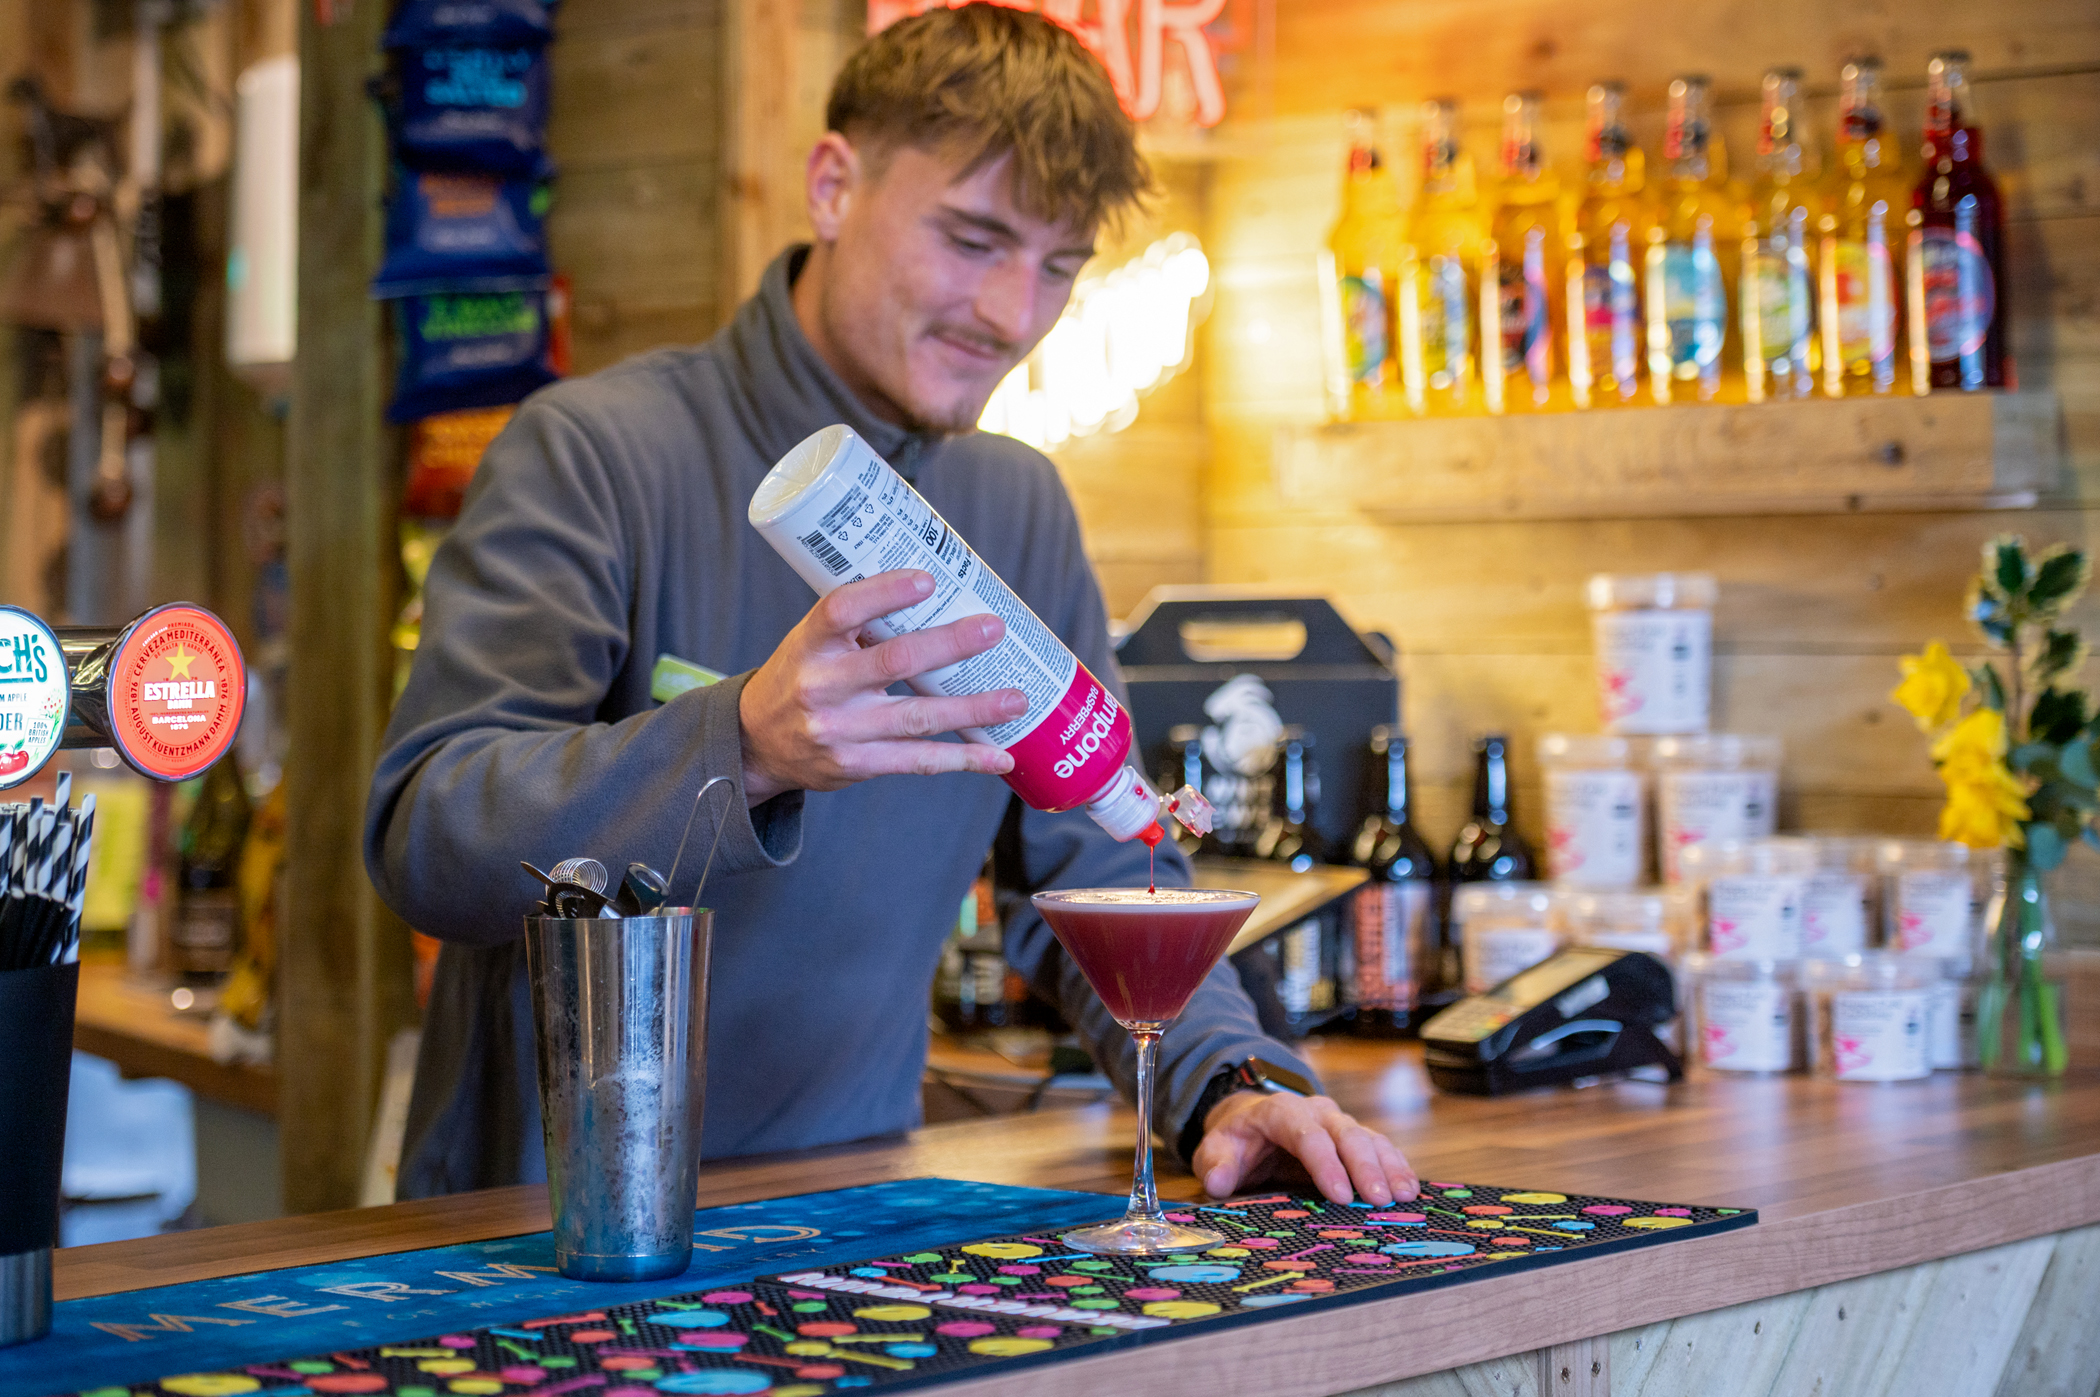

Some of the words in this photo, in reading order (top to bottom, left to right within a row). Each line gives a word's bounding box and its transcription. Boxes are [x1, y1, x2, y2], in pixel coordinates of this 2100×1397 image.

[852, 538, 864, 550] ITALY
[924, 525, 939, 547] 100
[957, 556, 972, 580] Facts
[133, 635, 166, 677] CERVEZA
[8, 693, 27, 702] APPLE
[130, 681, 139, 704] 1876
[143, 680, 216, 702] ESTRELLA
[220, 678, 229, 701] 1876
[33, 722, 48, 730] 100%
[151, 714, 207, 725] BARCELONA
[1058, 684, 1100, 747] RASPBERRY
[28, 729, 49, 737] BRITISH
[131, 706, 154, 745] AUGUST
[151, 732, 211, 757] KUENTZMANN
[208, 703, 227, 735] DAMM
[1053, 690, 1122, 780] ampone
[88, 1224, 822, 1343] MERMID
